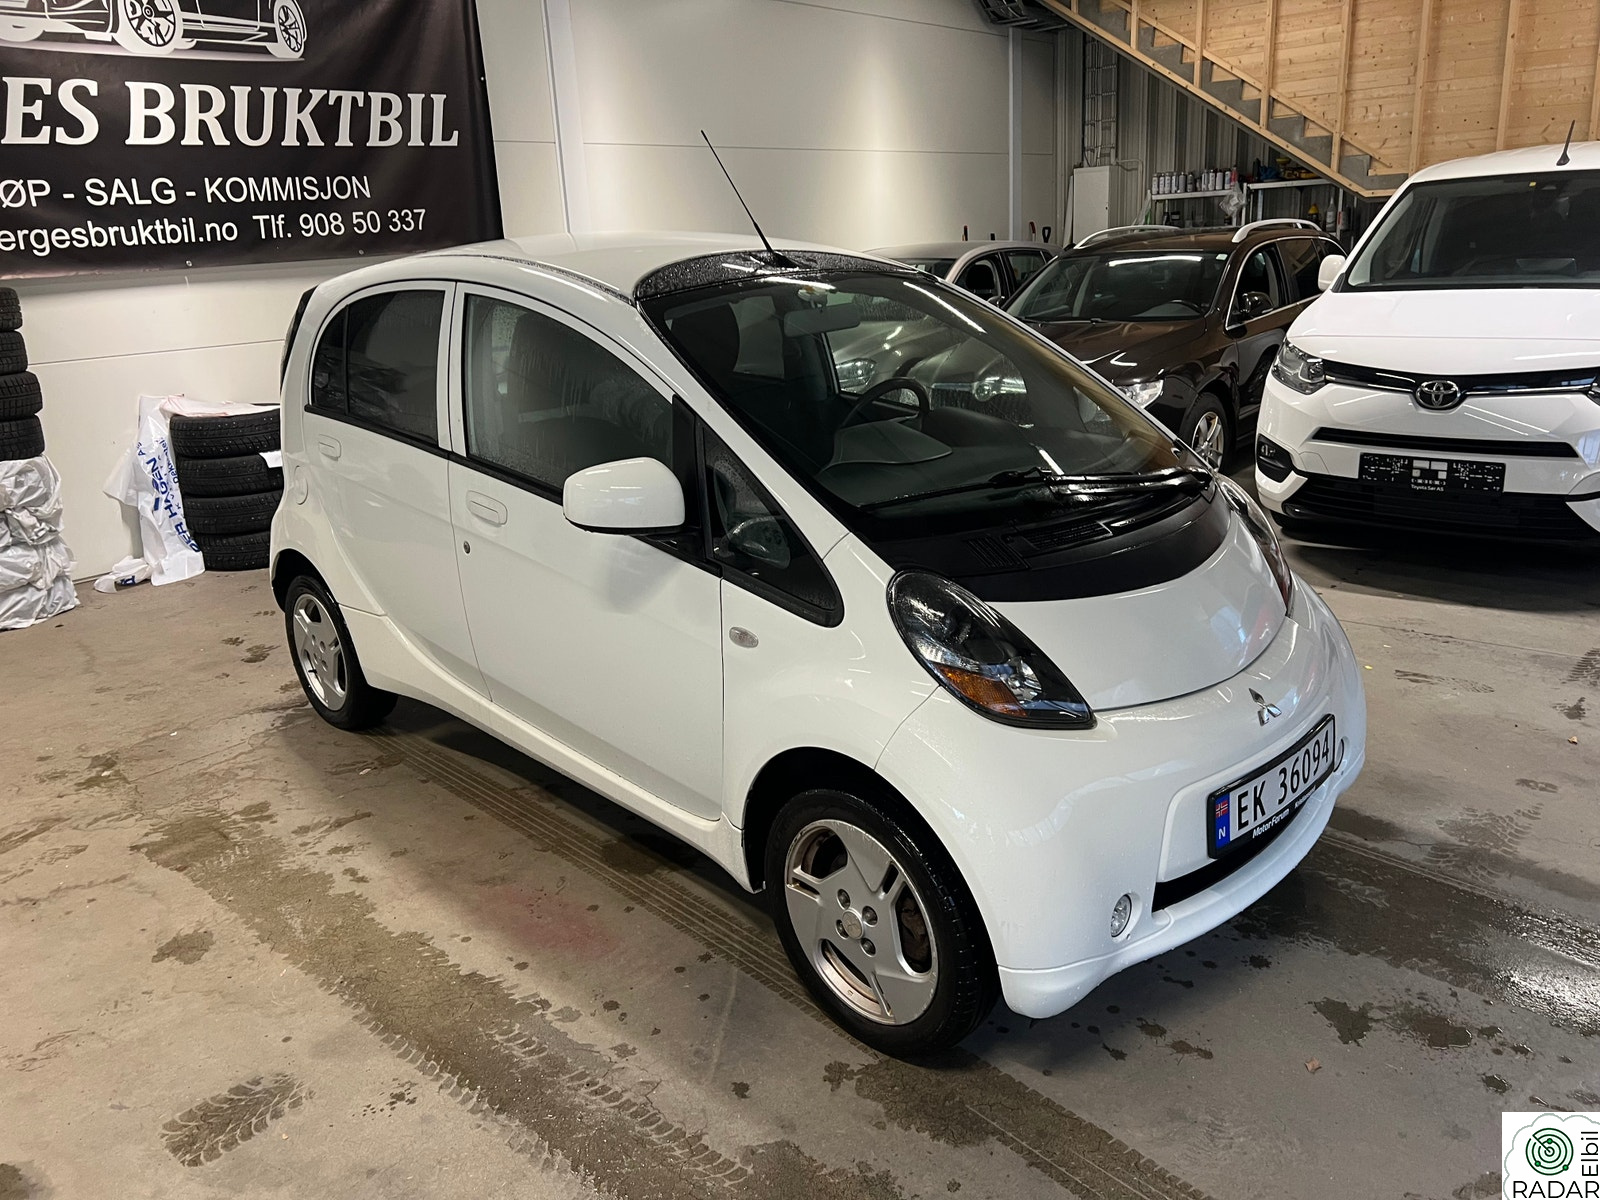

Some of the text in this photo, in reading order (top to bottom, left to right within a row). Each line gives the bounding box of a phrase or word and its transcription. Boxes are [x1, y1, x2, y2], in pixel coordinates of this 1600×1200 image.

[1, 76, 459, 148] ES BRUKTBIL
[0, 179, 51, 208] ØP
[85, 180, 175, 206] SALG
[206, 175, 371, 203] KOMMISJON
[0, 208, 426, 256] ergesbruktbil.no Tlf. 908 50 337
[1237, 730, 1330, 831] EK 36094
[1218, 826, 1227, 840] N
